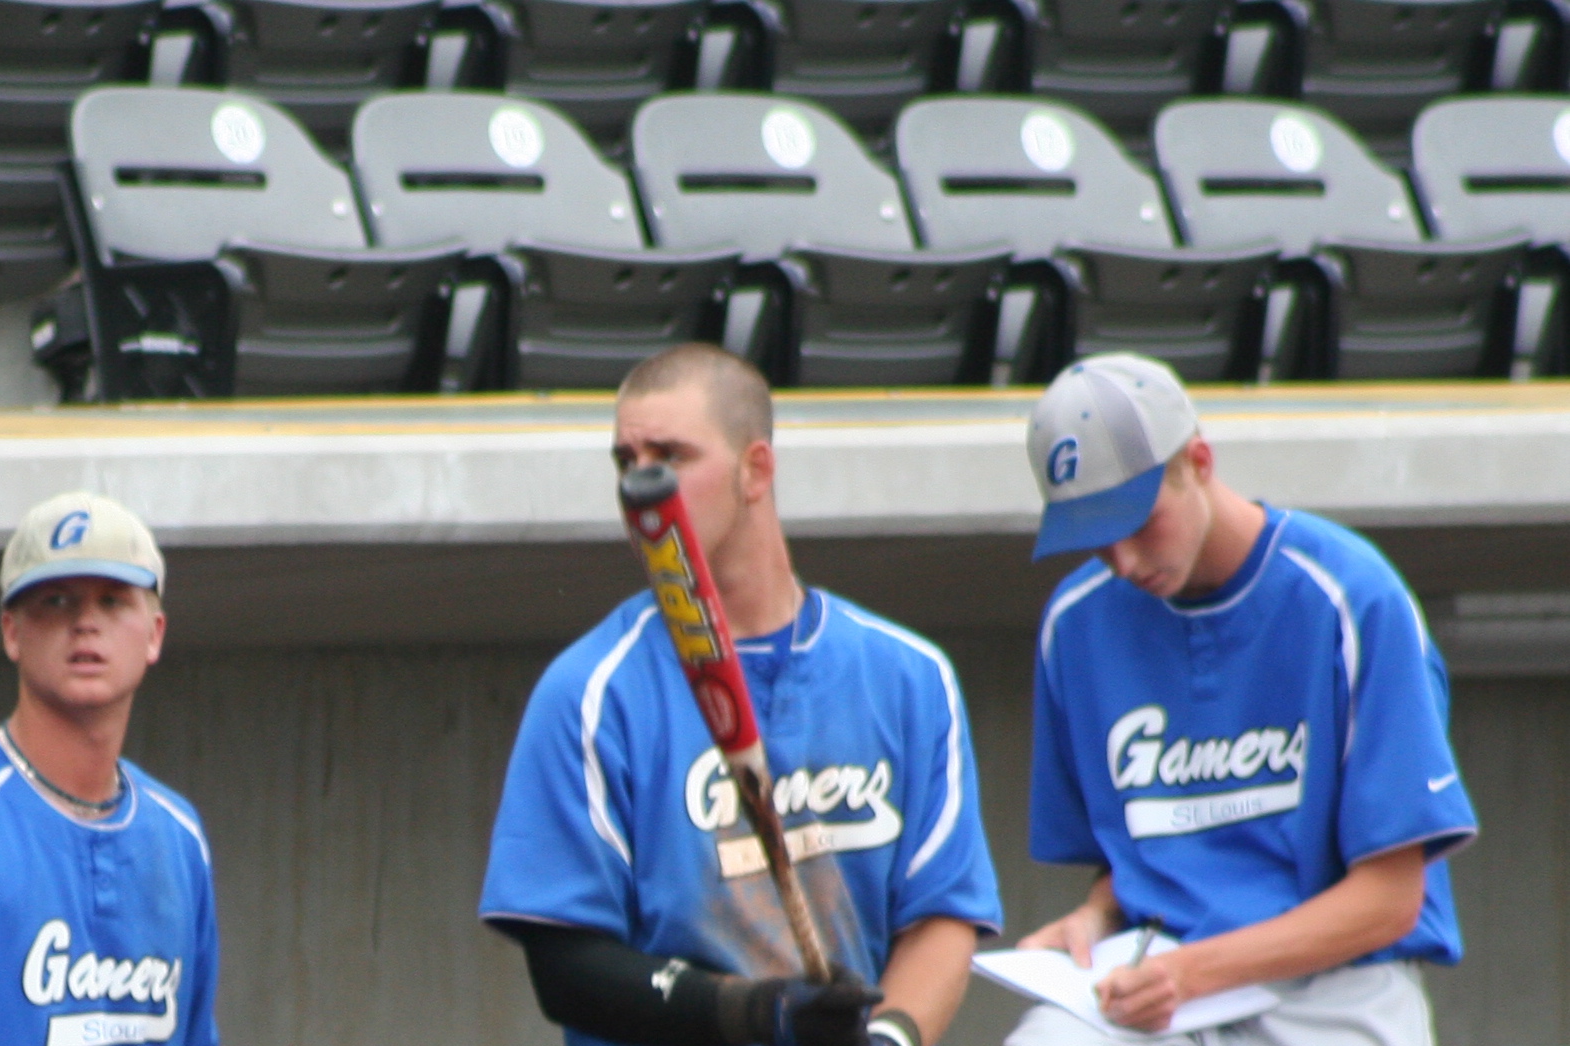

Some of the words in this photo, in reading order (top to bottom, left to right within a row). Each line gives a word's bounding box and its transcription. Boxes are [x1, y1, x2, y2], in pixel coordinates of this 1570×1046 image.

[1046, 436, 1079, 487] G
[49, 509, 90, 550] G
[1107, 704, 1308, 791] Gamers
[685, 746, 893, 831] Gmers
